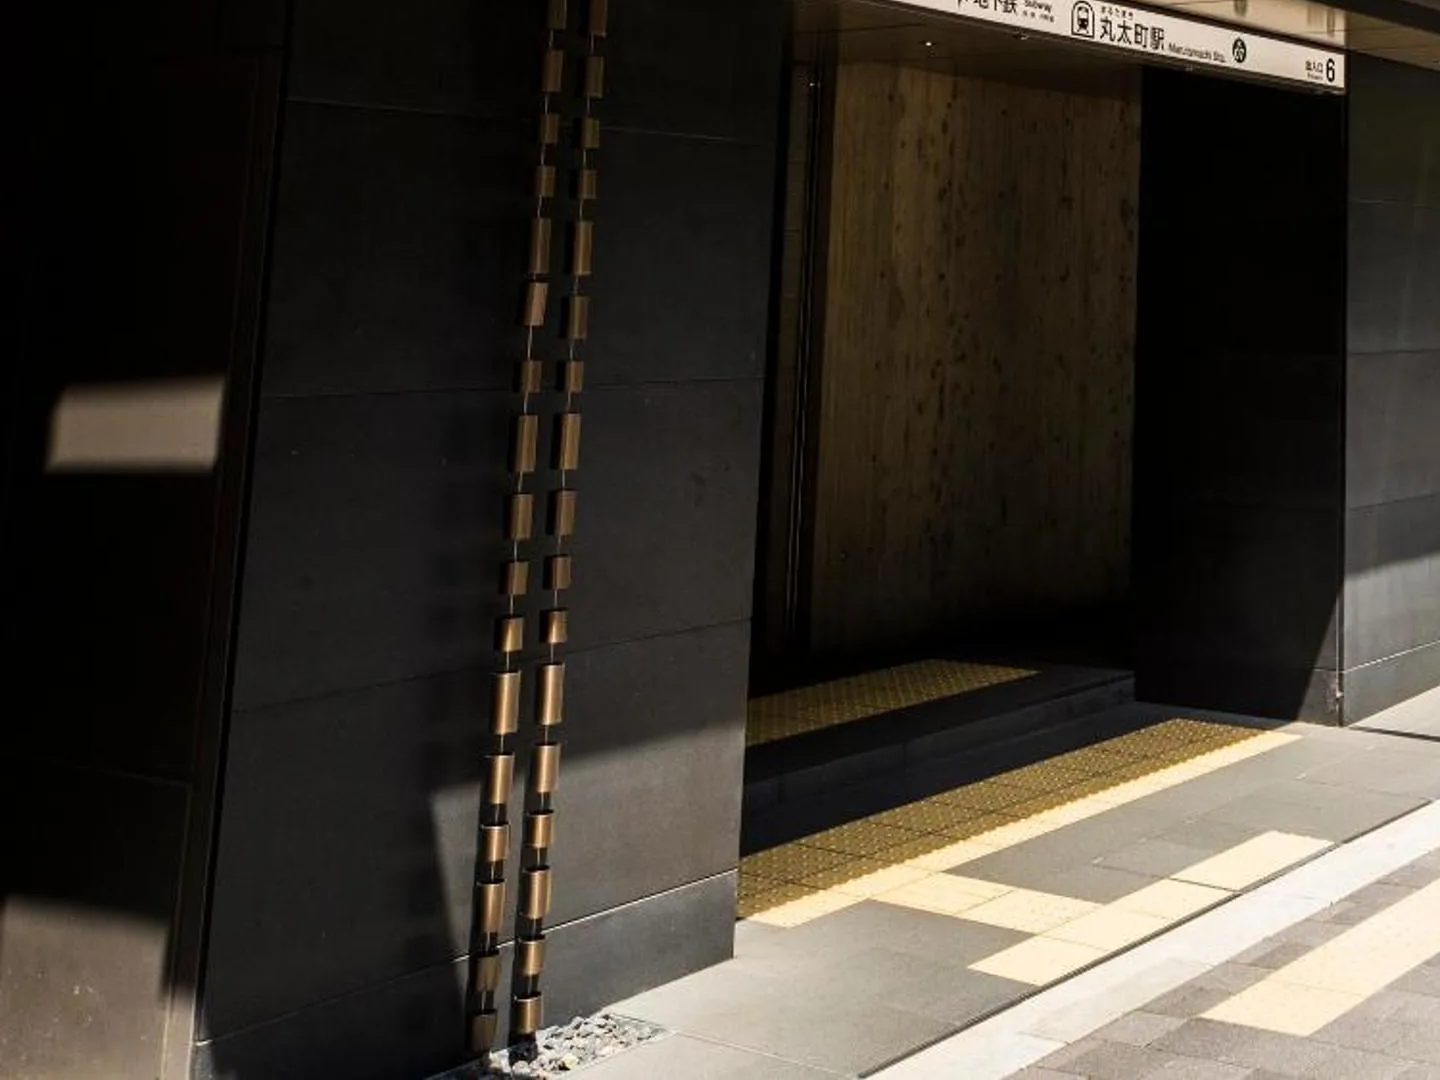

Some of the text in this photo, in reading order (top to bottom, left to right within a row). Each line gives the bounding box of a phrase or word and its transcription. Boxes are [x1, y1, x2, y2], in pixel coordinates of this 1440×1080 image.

[1100, 16, 1165, 51] 丸太町駅
[1326, 58, 1335, 82] 6
